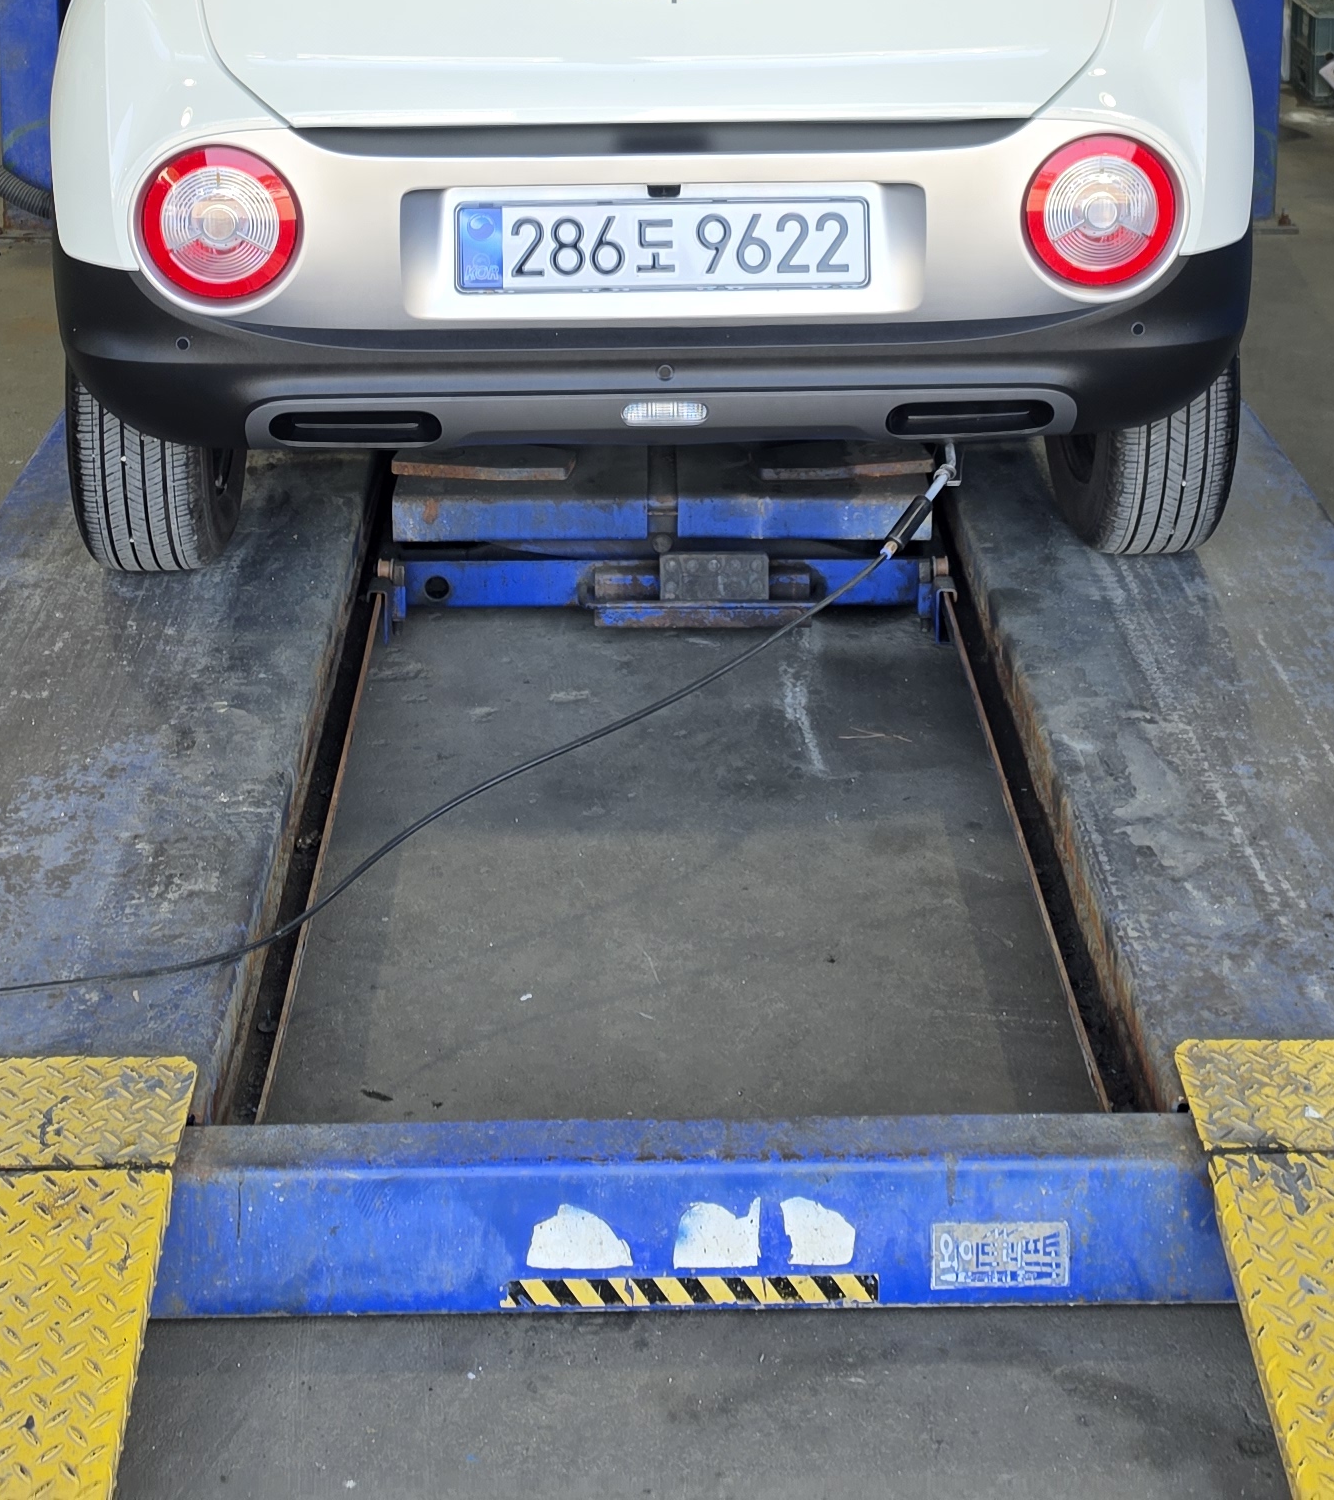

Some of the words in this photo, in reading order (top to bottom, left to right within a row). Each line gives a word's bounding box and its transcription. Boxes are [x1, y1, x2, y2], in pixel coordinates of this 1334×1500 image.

[509, 214, 676, 278] 286도
[695, 213, 851, 275] 9622
[464, 264, 500, 281] KOR
